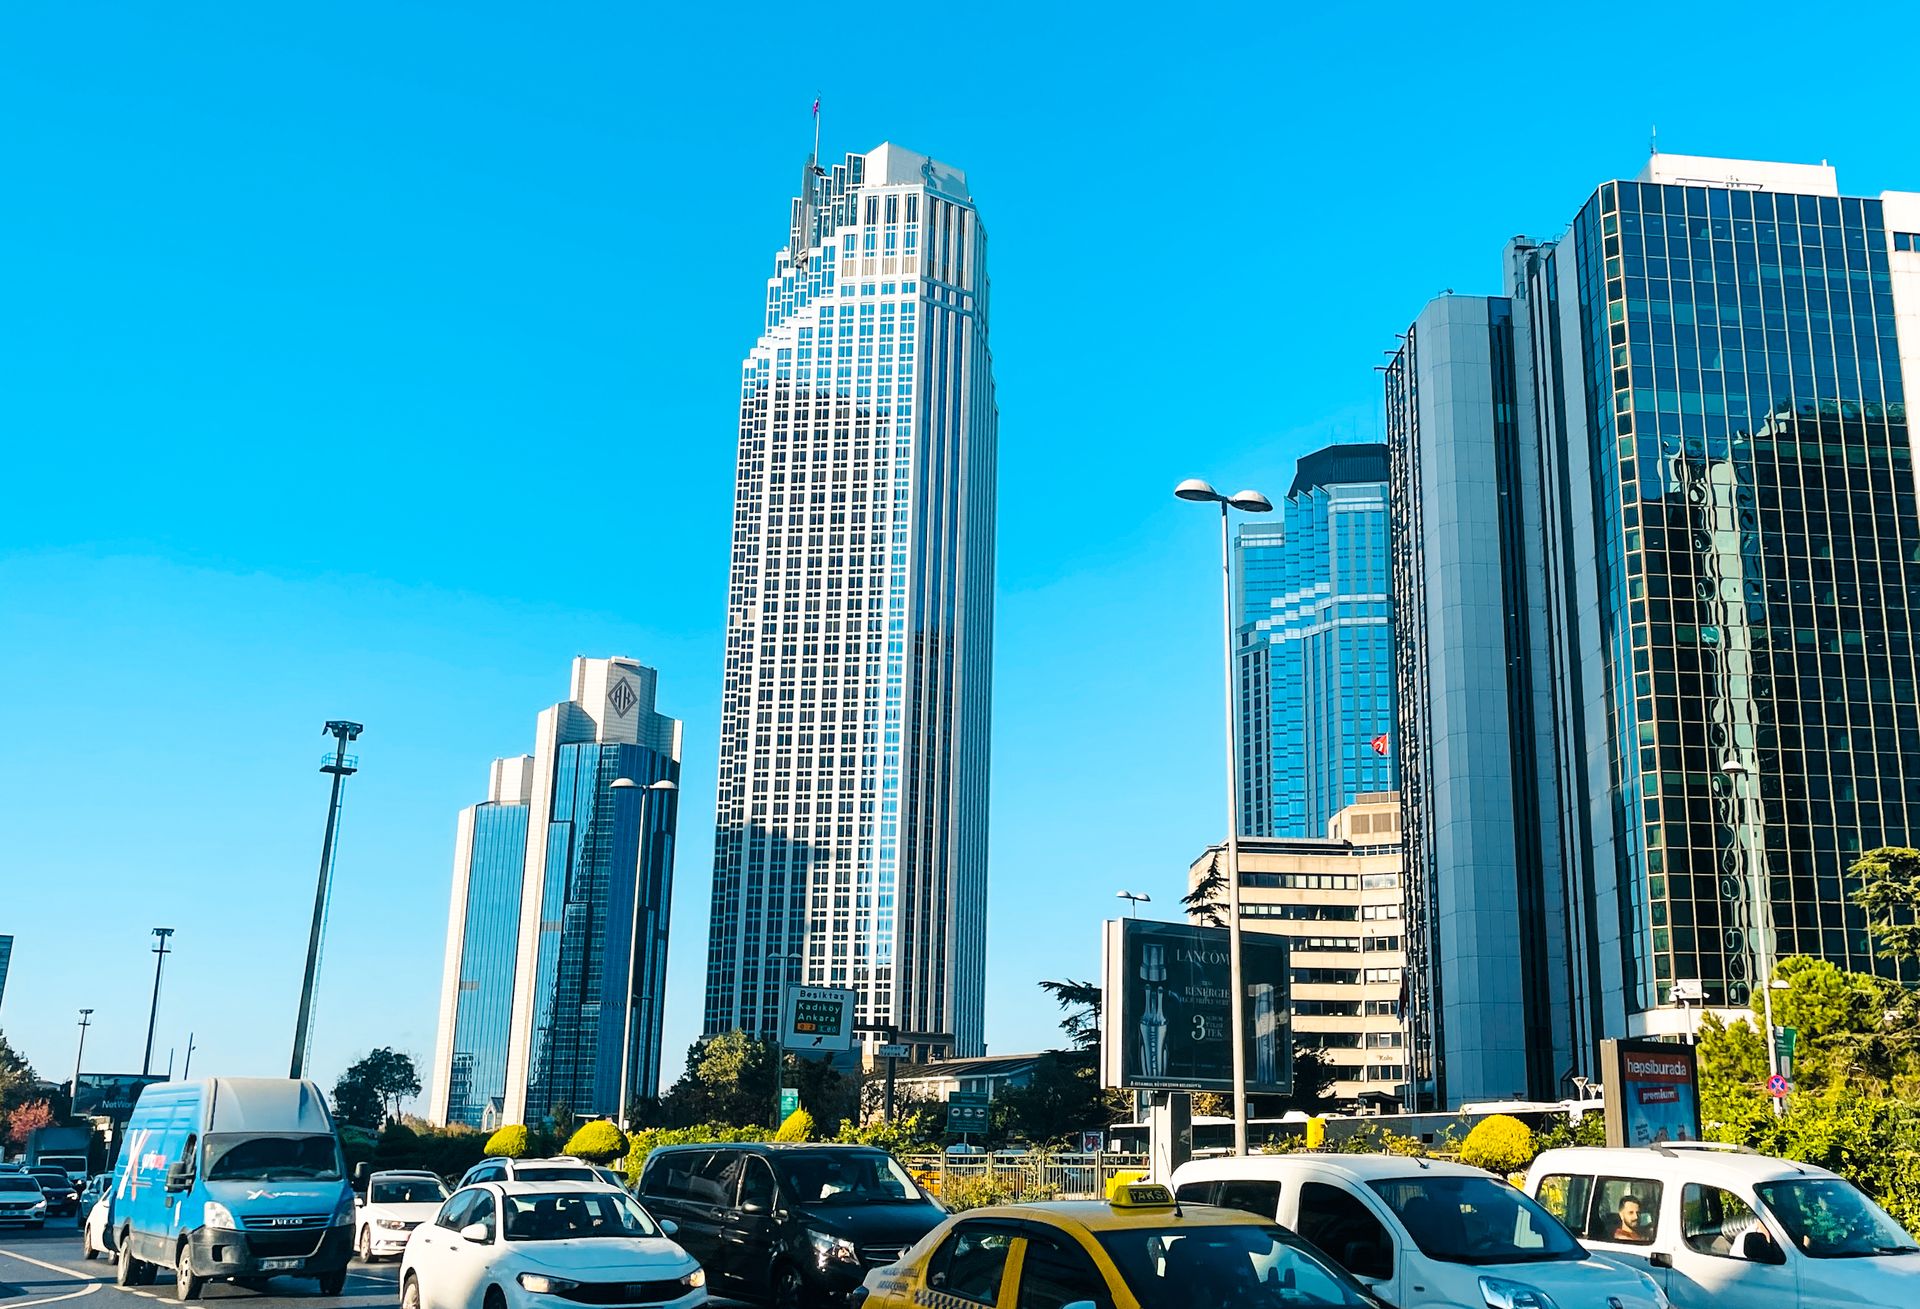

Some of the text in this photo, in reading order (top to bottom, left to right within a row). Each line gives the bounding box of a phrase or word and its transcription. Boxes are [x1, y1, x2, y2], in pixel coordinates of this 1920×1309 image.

[798, 1013, 835, 1023] Ankara
[1191, 1014, 1206, 1040] 3
[1627, 1058, 1687, 1077] hepsiburada
[1642, 1088, 1675, 1103] premium
